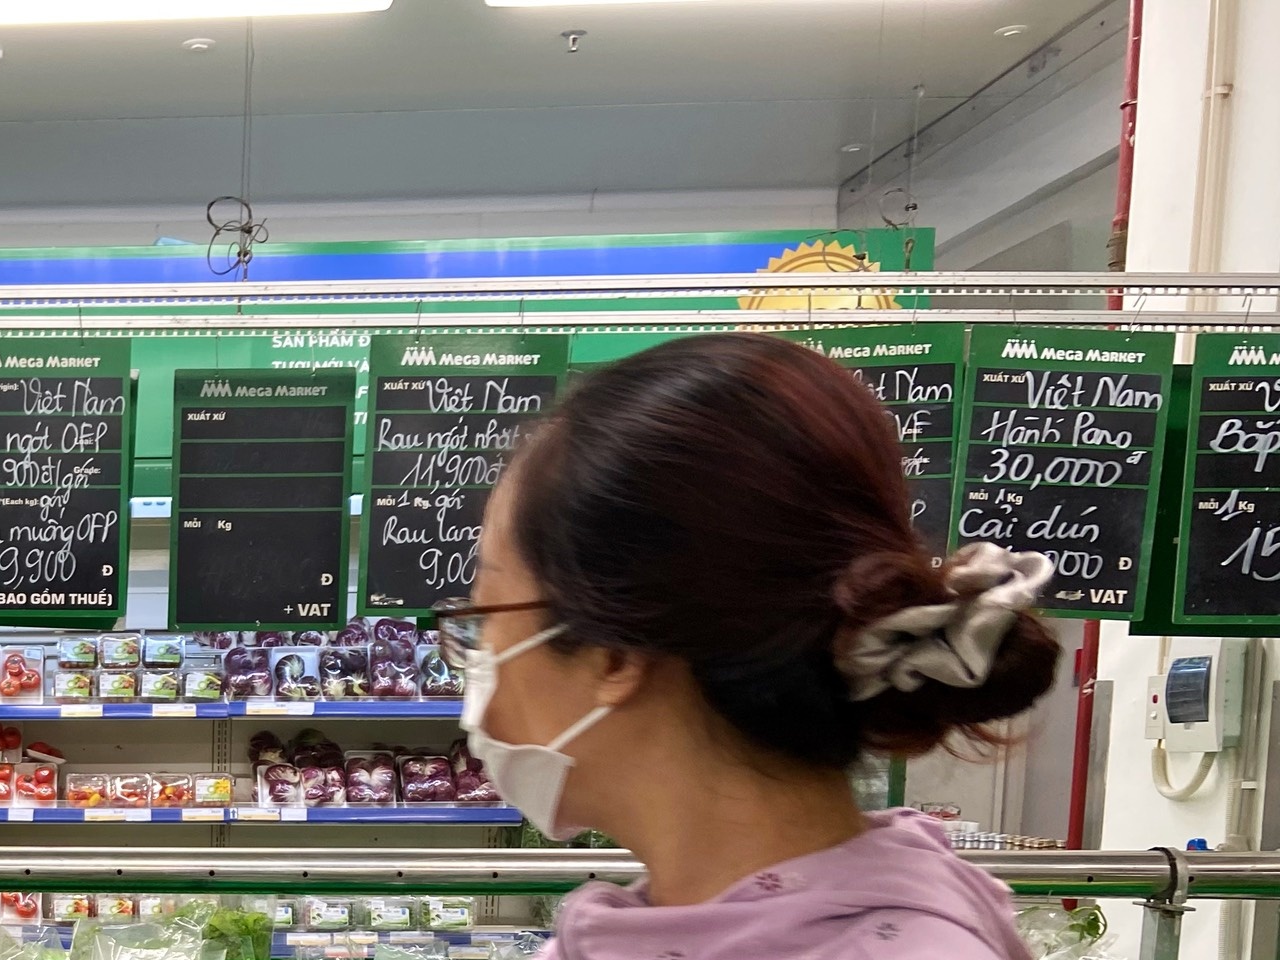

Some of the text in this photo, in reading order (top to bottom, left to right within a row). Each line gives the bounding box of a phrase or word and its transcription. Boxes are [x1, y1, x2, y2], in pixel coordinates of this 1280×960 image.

[72, 378, 126, 417] Nam
[482, 378, 541, 414] Nam
[895, 367, 952, 403] Nam
[1091, 375, 1163, 411] Nam
[377, 418, 423, 451] Rau
[217, 519, 232, 531] Kg
[382, 515, 433, 546] Rau
[297, 603, 332, 617] VAT
[1090, 589, 1127, 604] VAT
